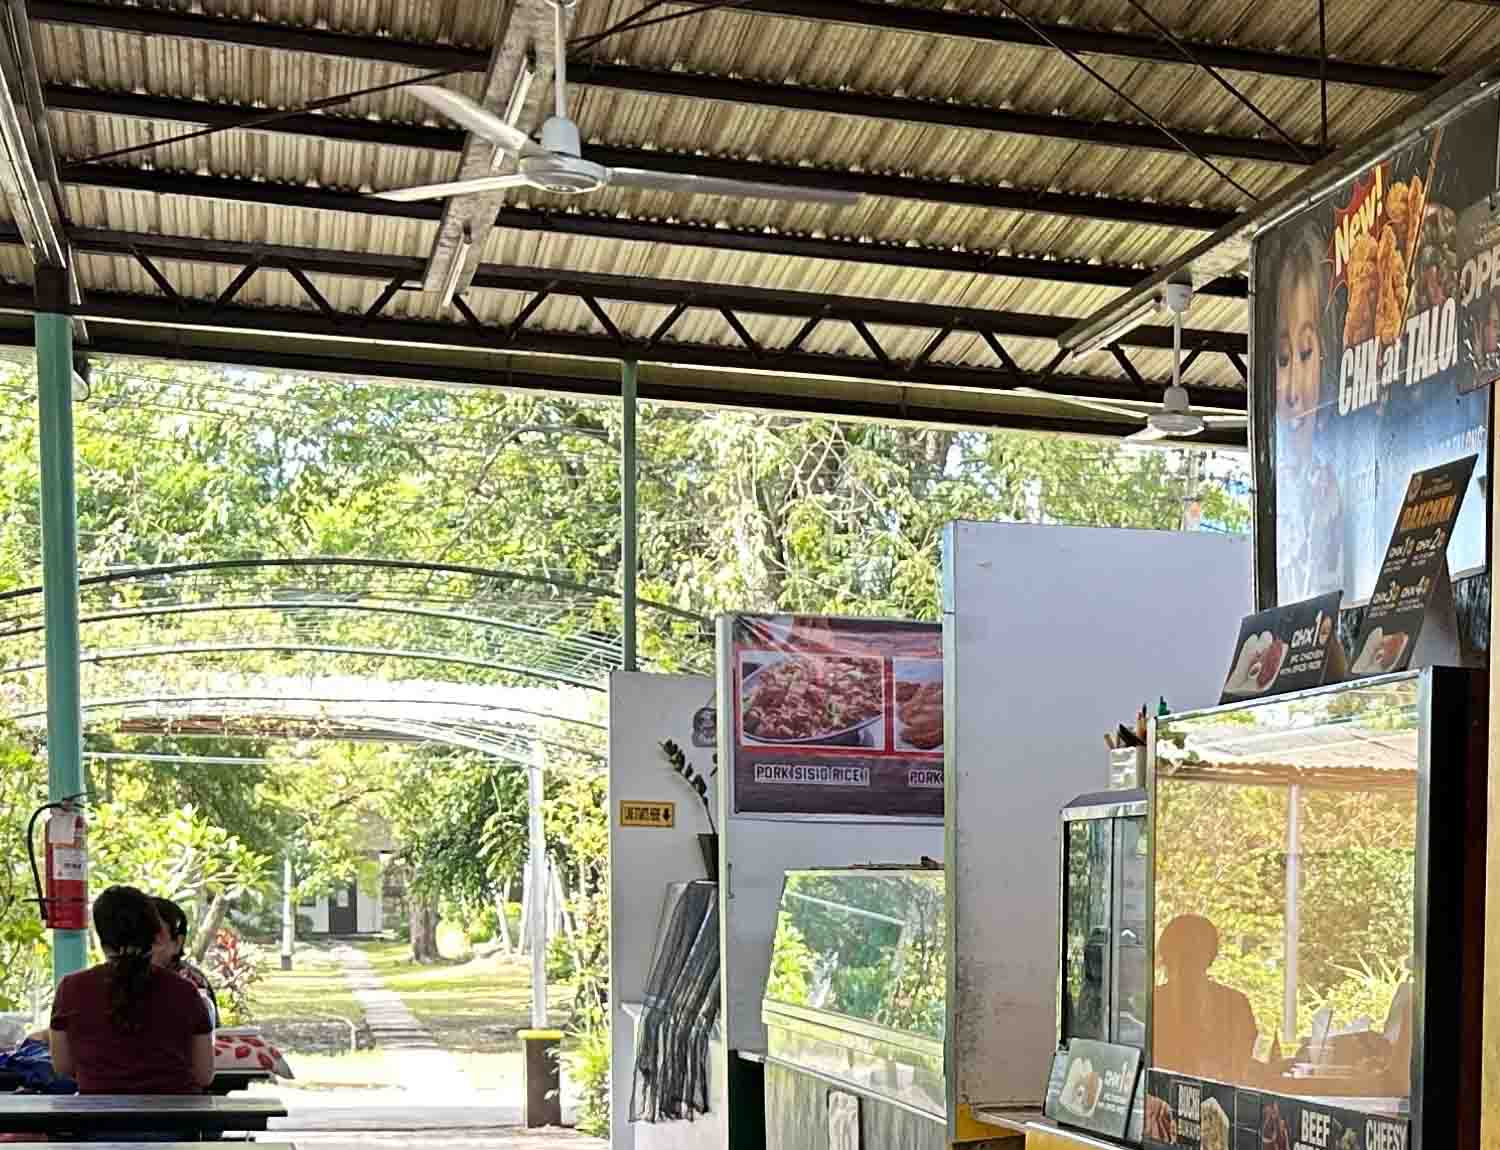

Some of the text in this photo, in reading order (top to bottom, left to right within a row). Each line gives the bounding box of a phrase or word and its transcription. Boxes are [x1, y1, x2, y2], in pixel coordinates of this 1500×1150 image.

[1405, 297, 1459, 386] TALO
[756, 765, 790, 780] PORK
[1301, 1108, 1331, 1147] BEEF
